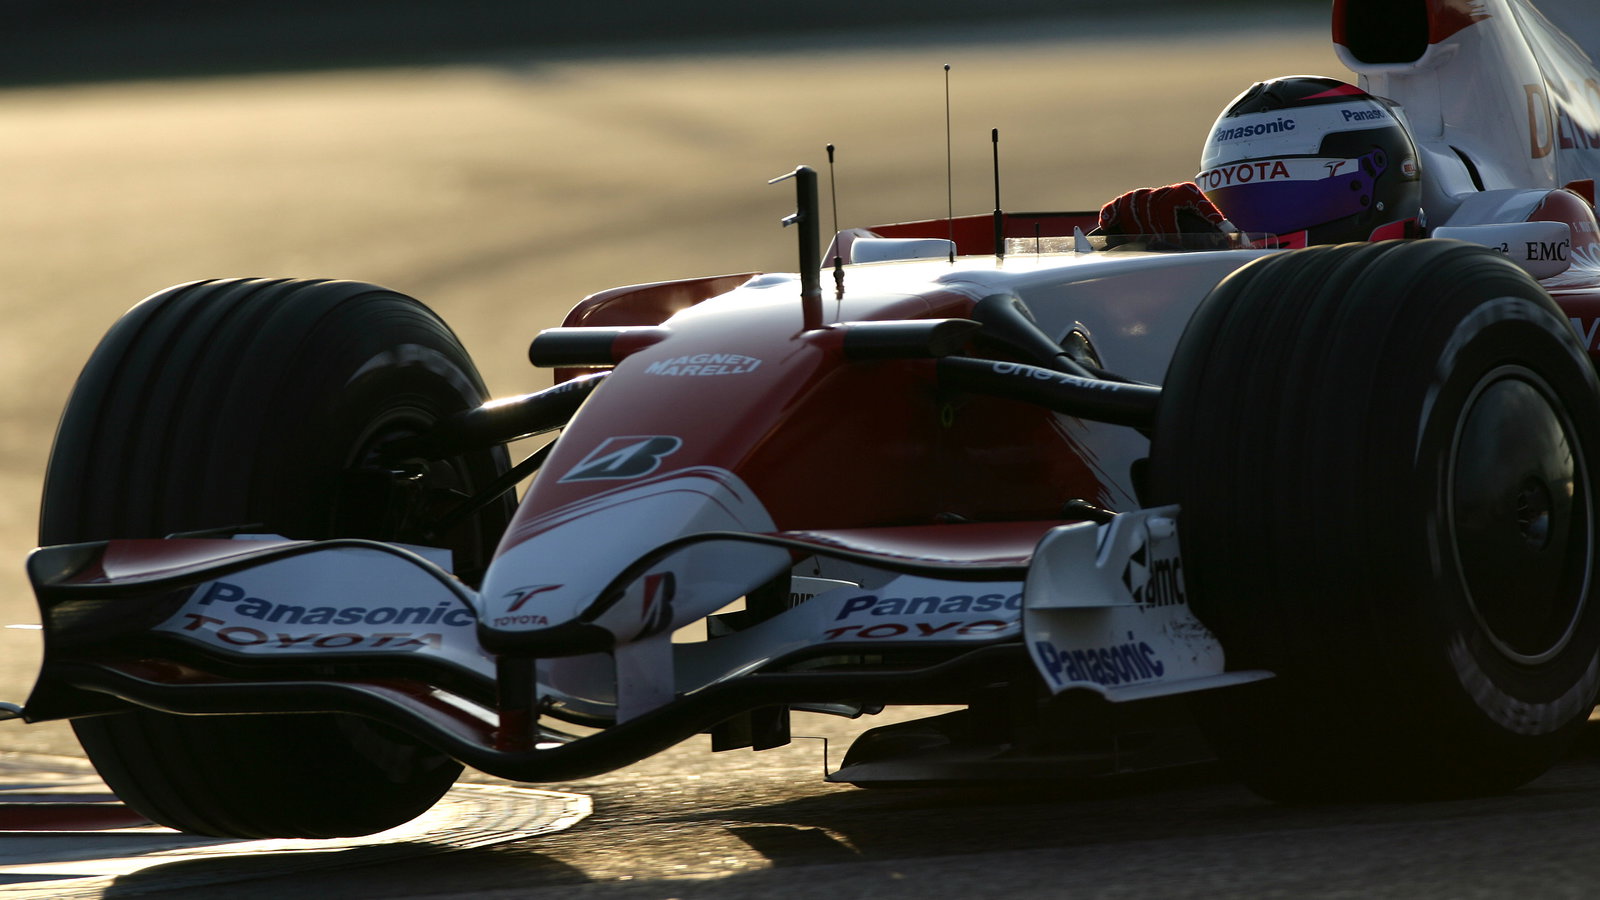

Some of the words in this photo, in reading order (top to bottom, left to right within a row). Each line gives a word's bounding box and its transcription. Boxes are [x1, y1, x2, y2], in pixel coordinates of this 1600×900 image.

[1213, 117, 1296, 143] Panasonic
[1201, 160, 1290, 190] TOYOTA
[198, 582, 476, 627] Panasonic
[493, 615, 549, 627] TOYOTA
[183, 613, 443, 650] TOYOTA
[1035, 630, 1165, 685] Panasonic
